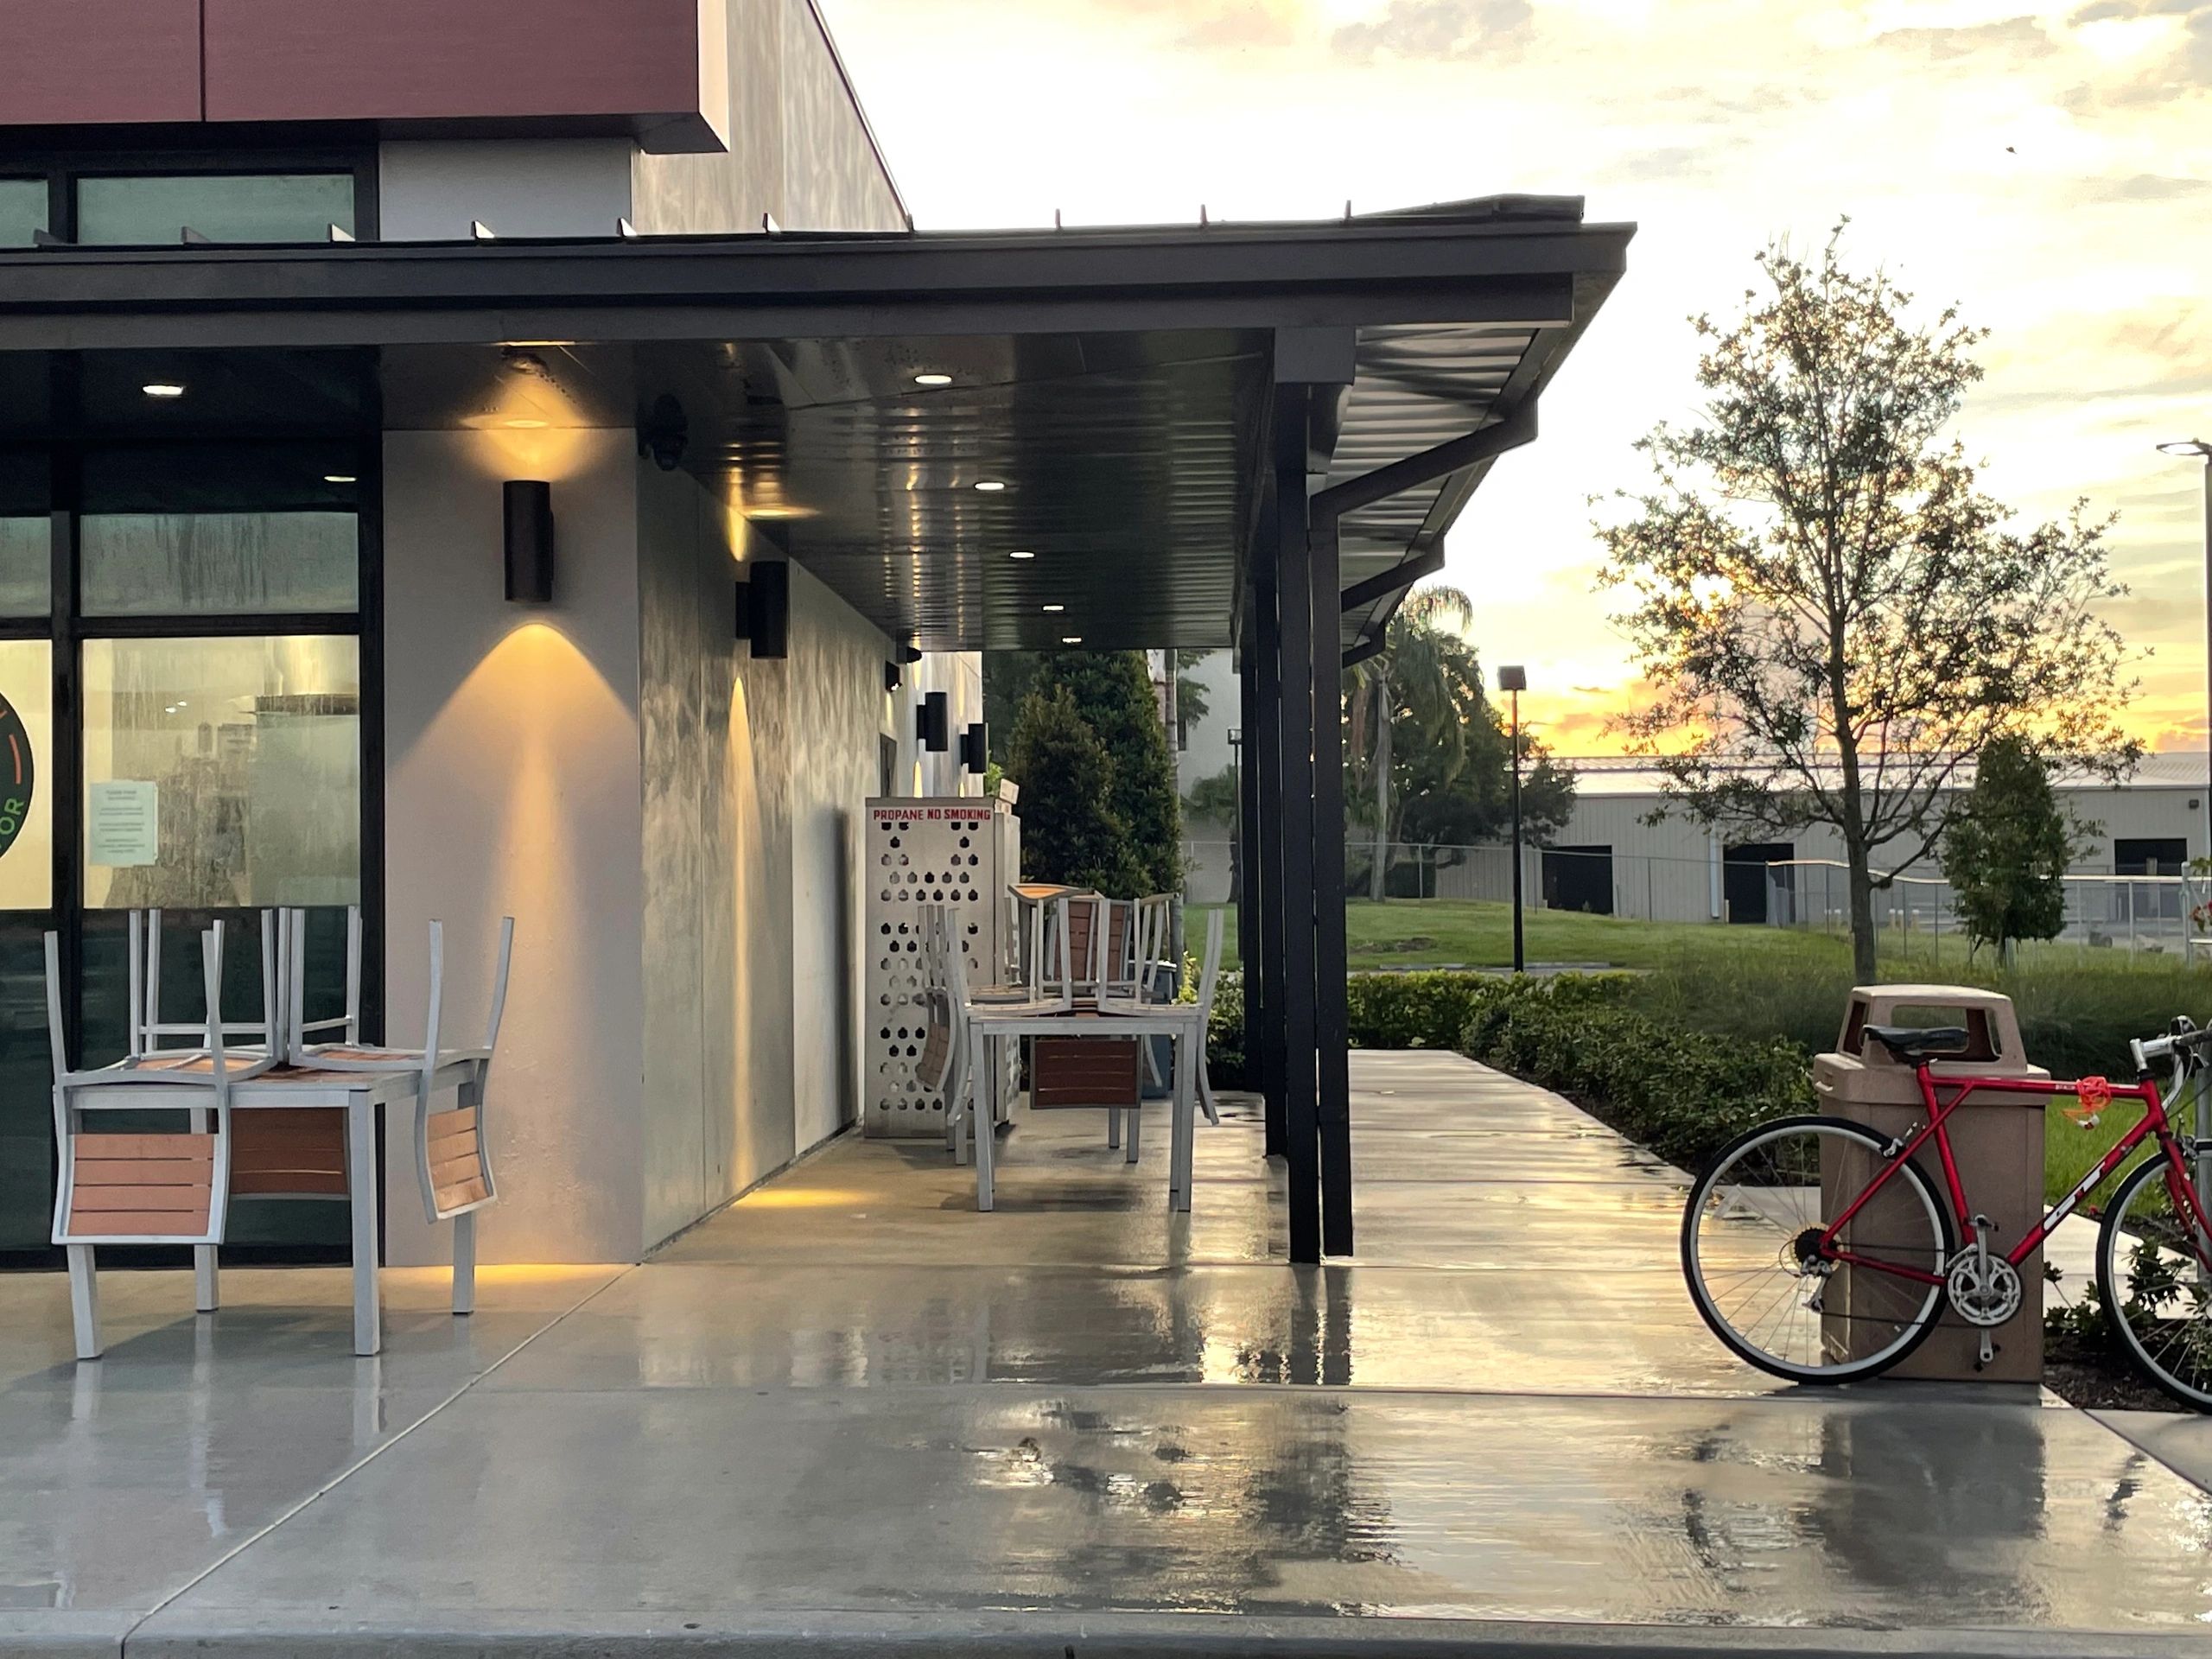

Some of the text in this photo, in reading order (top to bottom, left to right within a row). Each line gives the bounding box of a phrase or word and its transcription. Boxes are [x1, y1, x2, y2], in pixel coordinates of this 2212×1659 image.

[0, 798, 25, 849] OR
[874, 809, 991, 820] PROPANE NO SMOKING
[2043, 1160, 2106, 1231] GT
